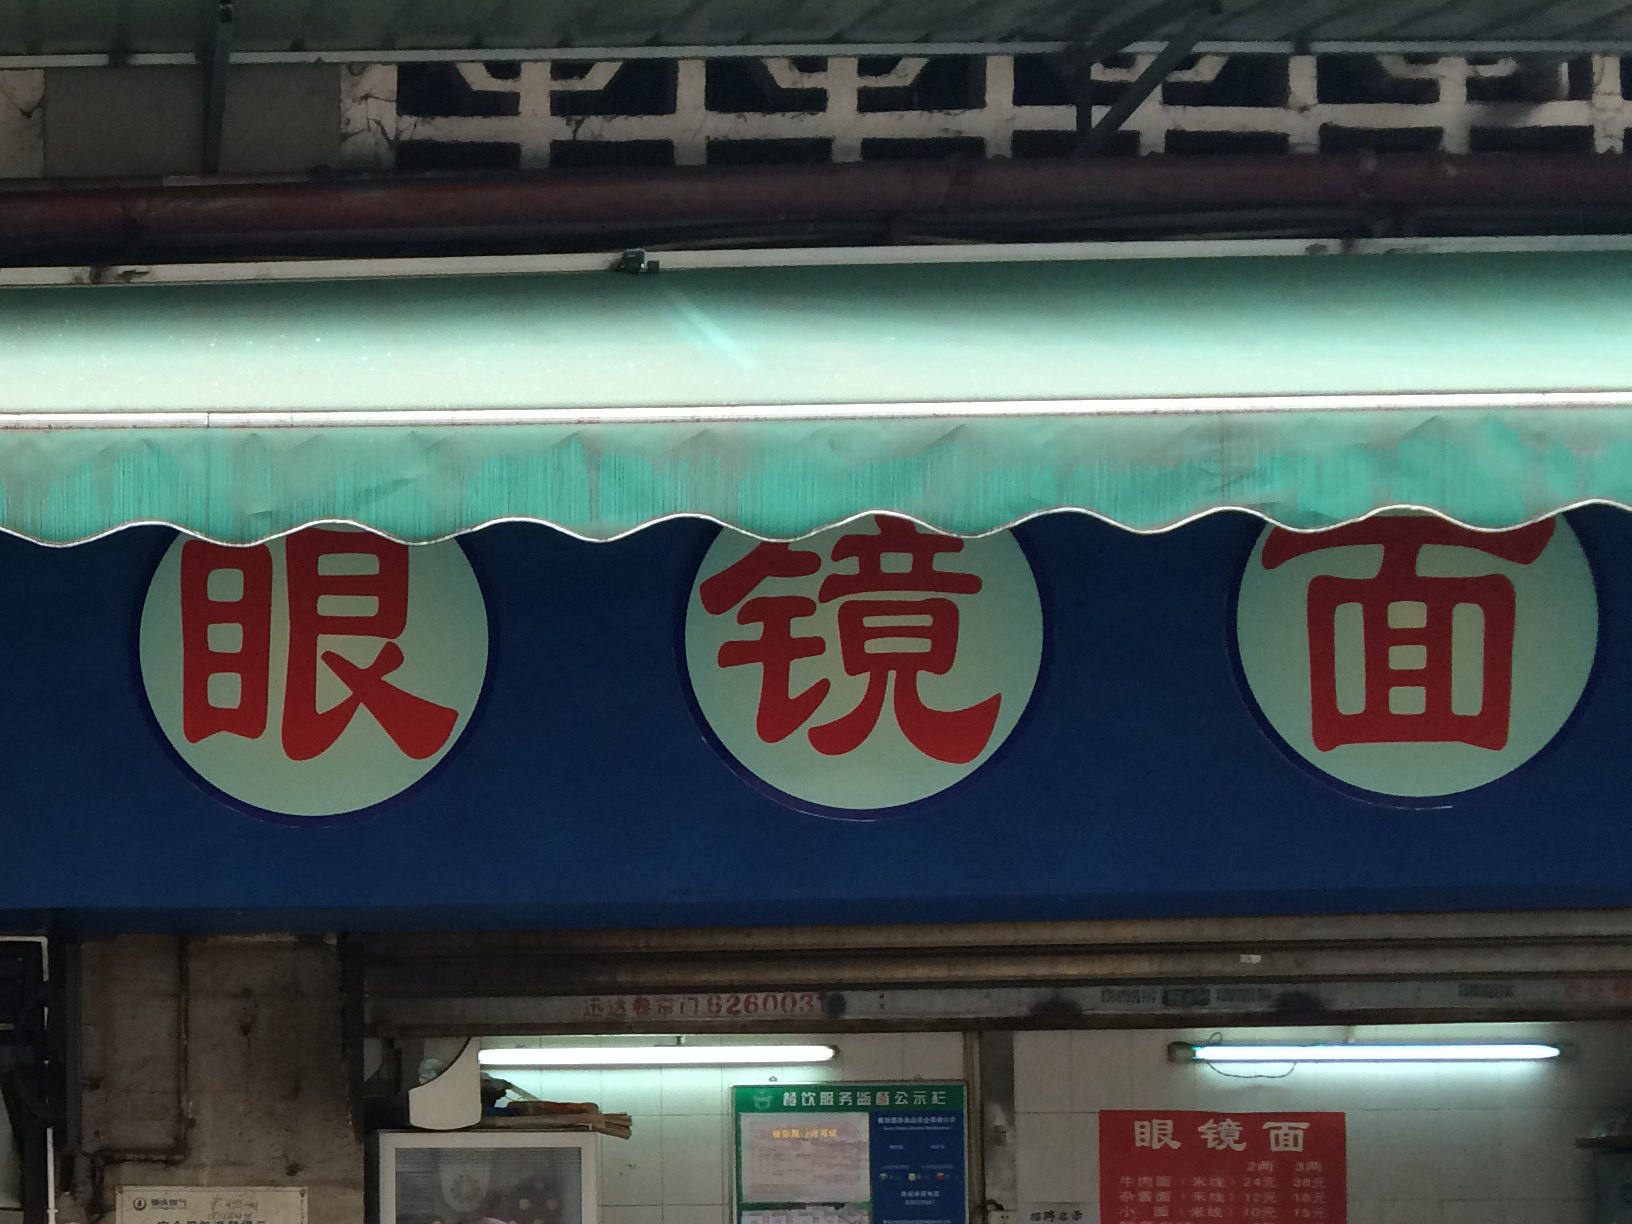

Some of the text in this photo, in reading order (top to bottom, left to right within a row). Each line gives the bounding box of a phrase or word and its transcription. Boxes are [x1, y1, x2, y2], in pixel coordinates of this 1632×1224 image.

[782, 1091, 946, 1107] 餐饮服务监督公示栏
[1133, 1118, 1310, 1152] 眼镜面
